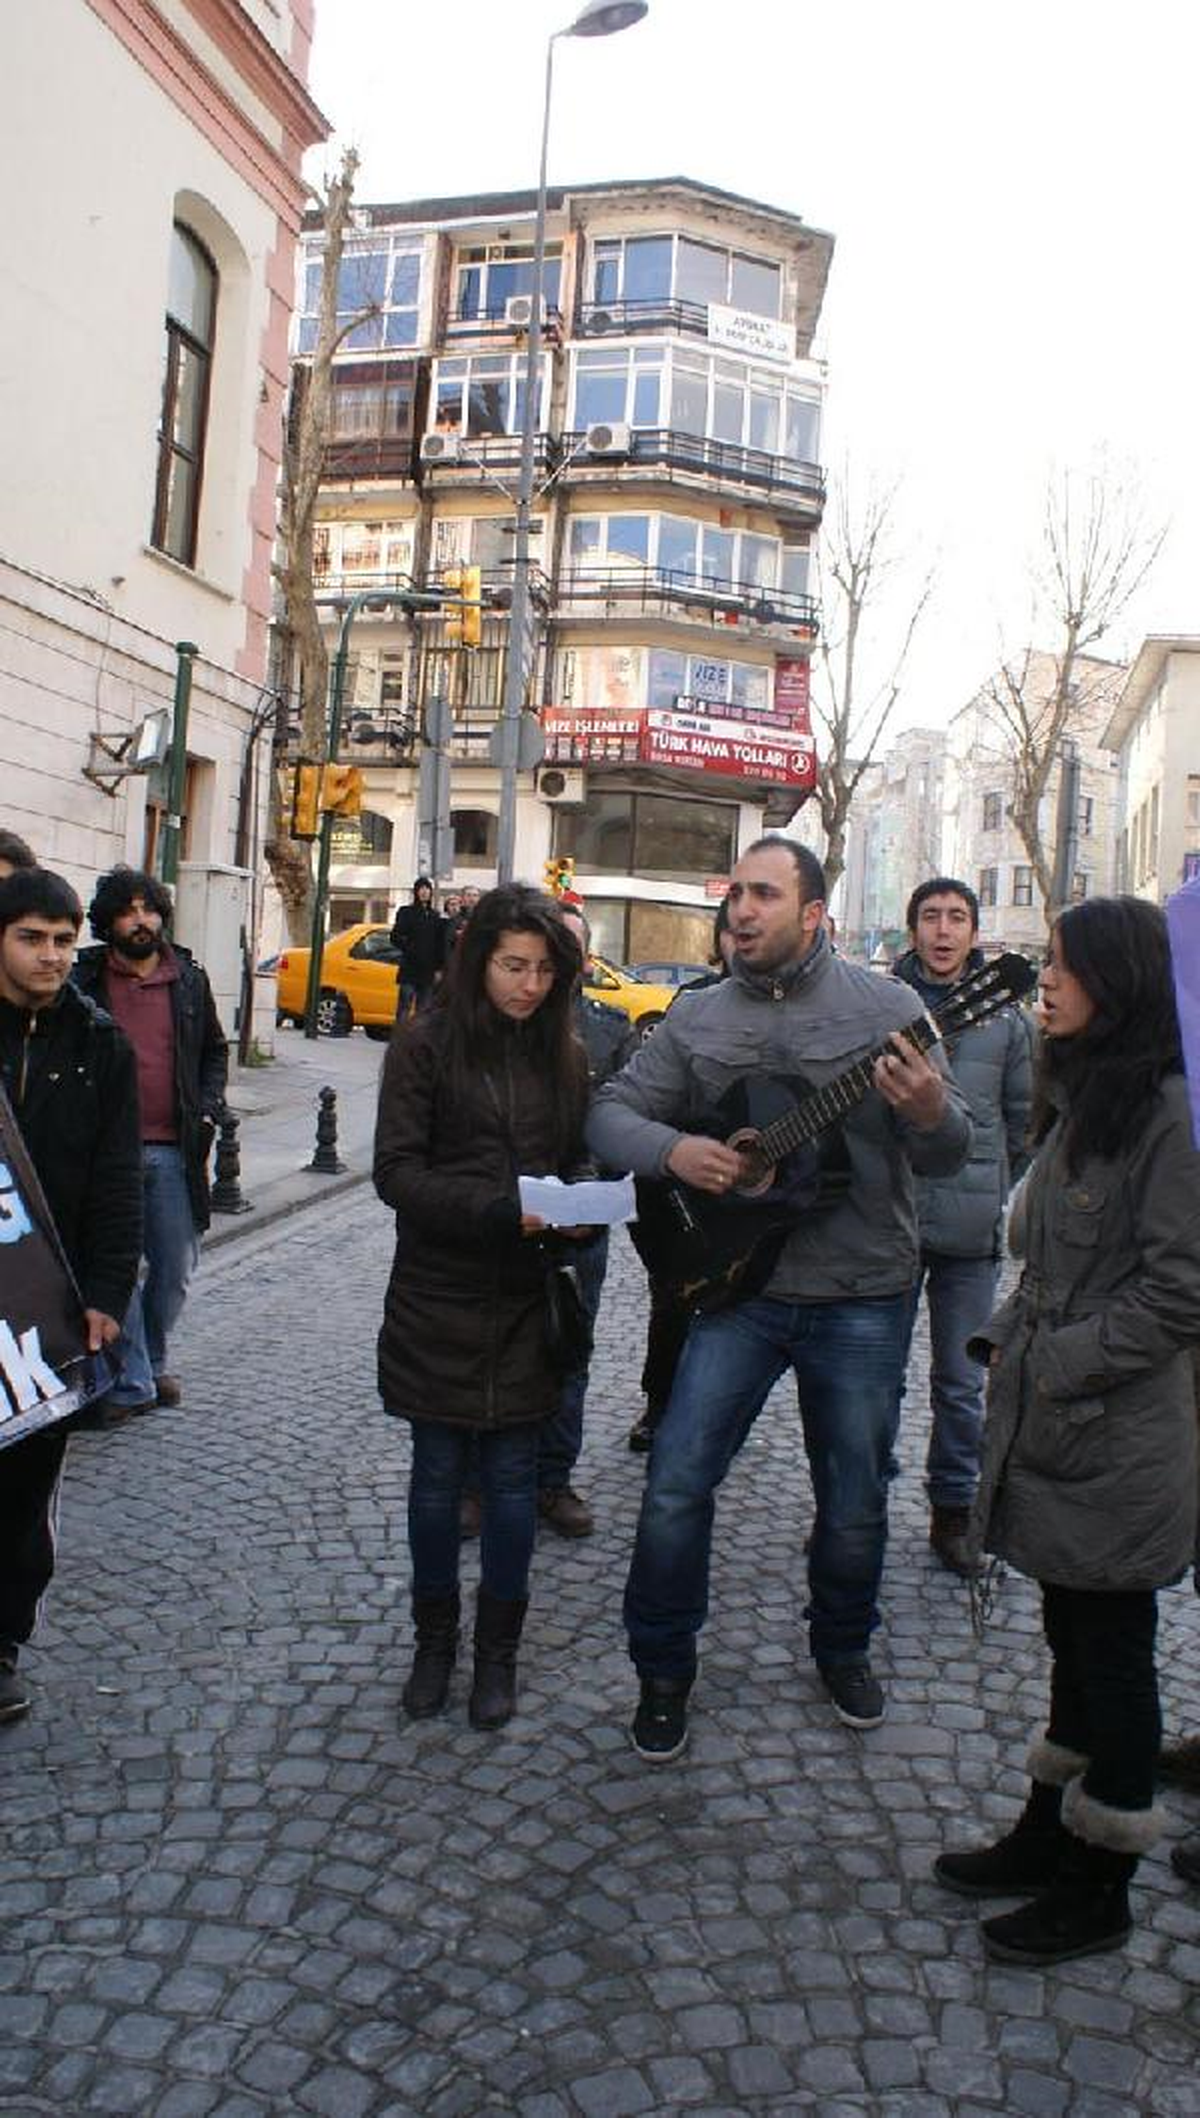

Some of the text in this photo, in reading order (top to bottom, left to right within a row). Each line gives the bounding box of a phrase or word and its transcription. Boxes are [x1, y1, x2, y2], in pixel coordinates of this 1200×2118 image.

[650, 729, 688, 752] TÜRK
[690, 736, 730, 758] HAVA
[732, 743, 788, 769] YOLLARI
